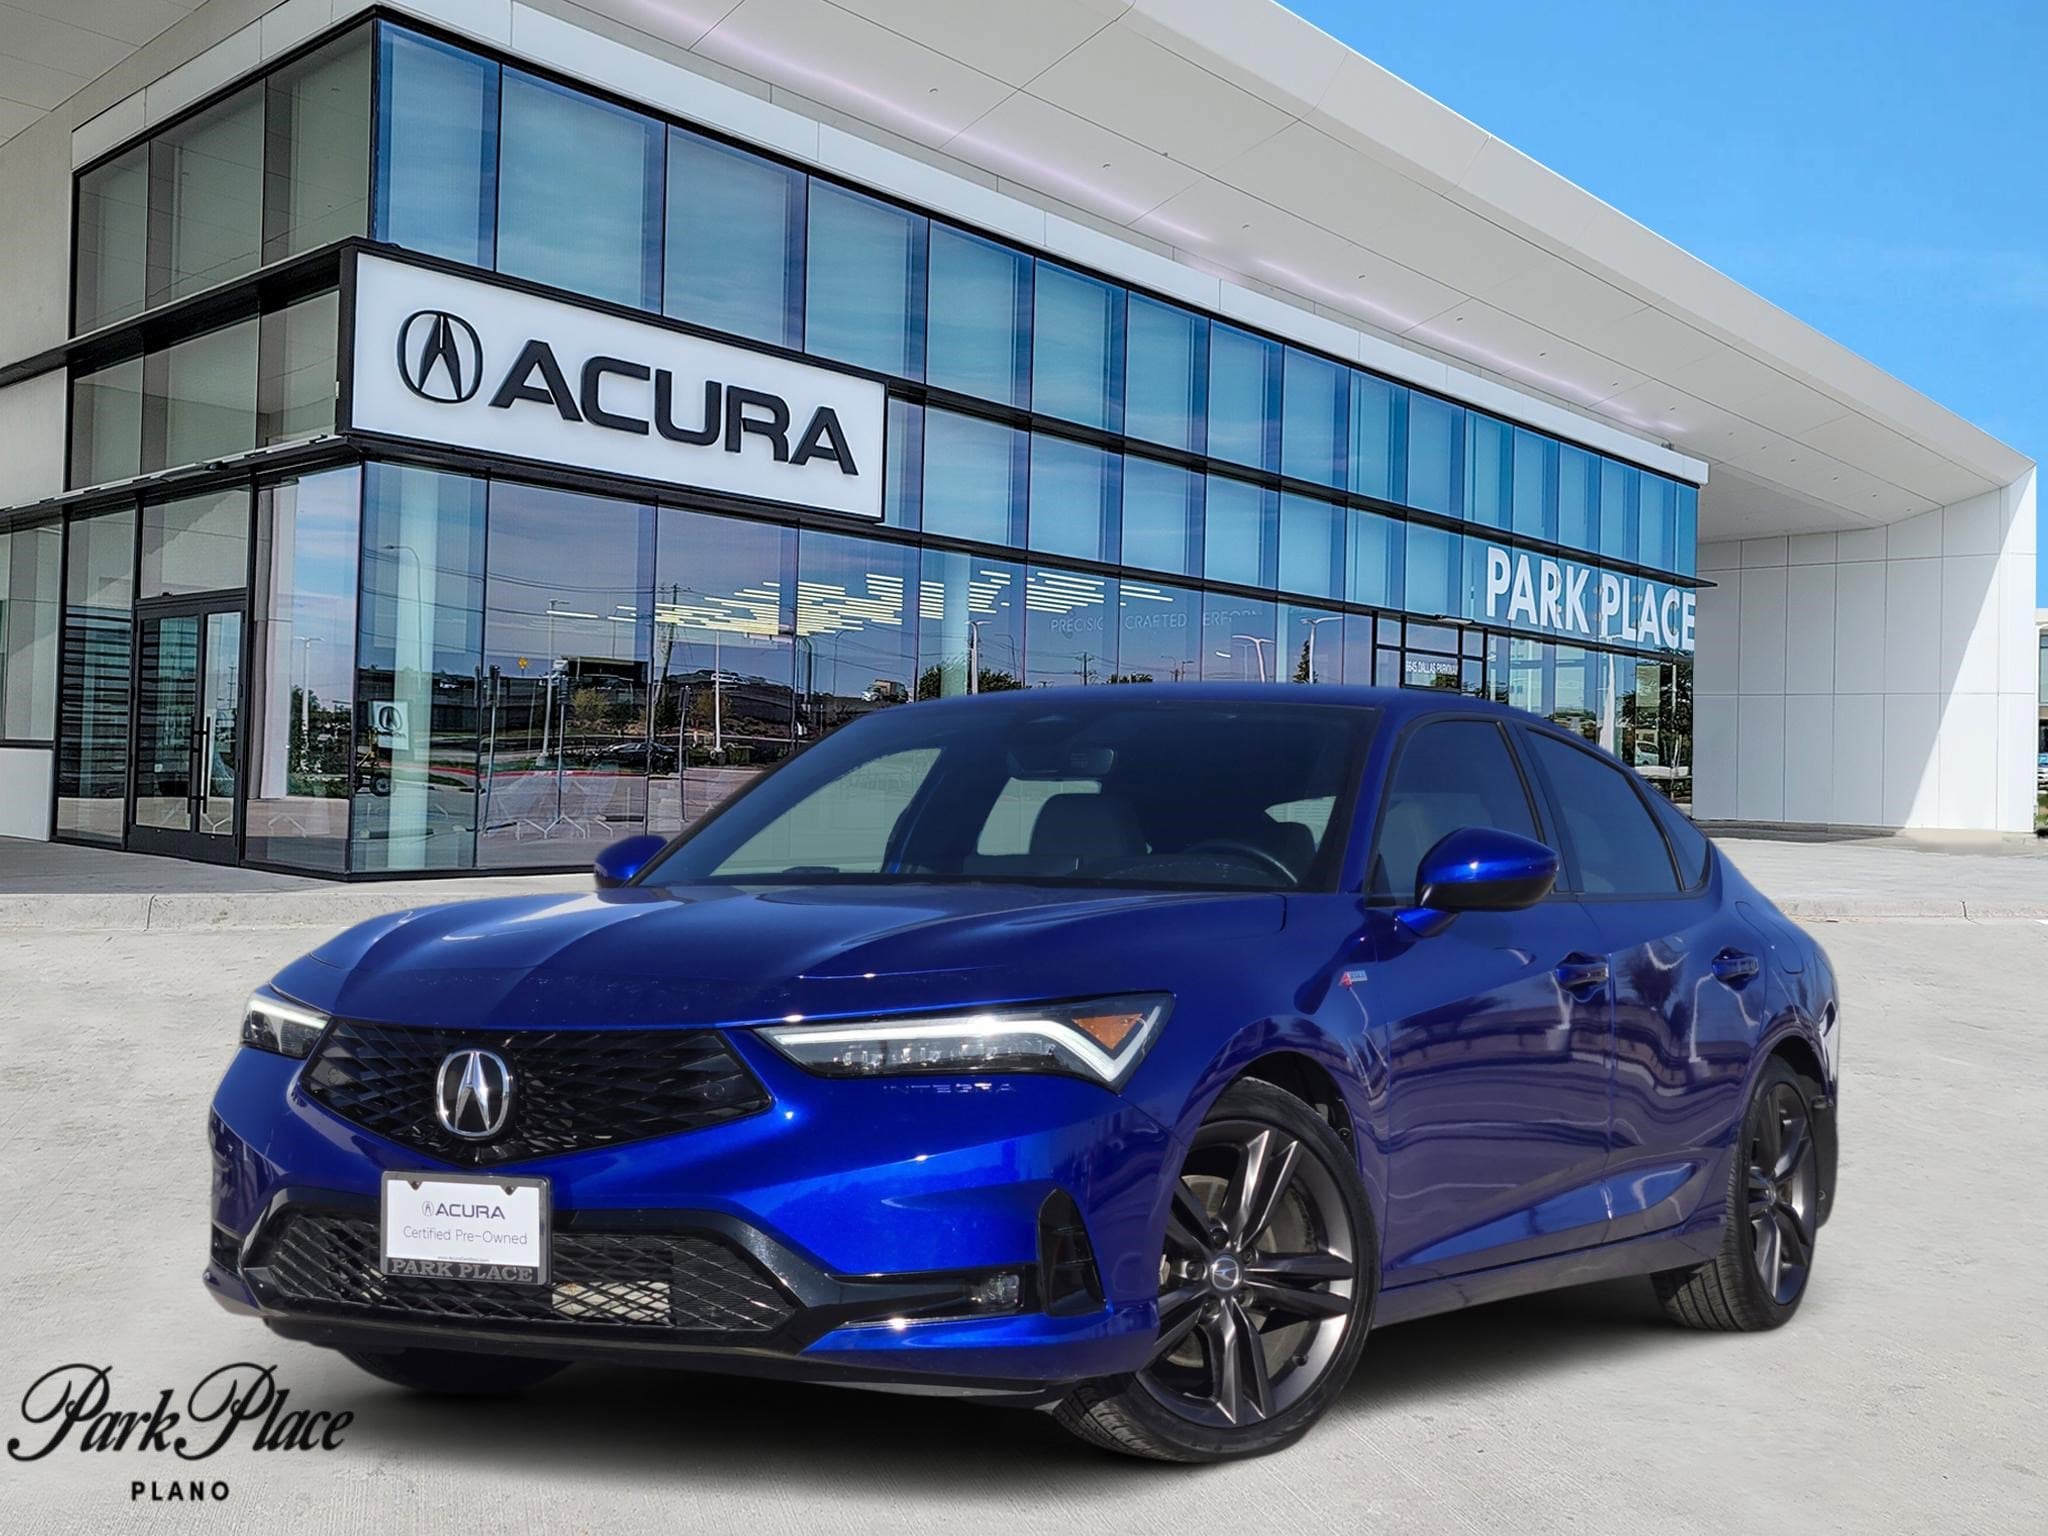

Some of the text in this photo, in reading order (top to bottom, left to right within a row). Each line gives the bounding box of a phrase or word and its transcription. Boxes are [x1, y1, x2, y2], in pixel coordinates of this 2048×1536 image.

[488, 339, 859, 476] ACURA
[1486, 546, 1696, 651] PARK PLACE
[1124, 613, 1188, 630] CRAFTED
[435, 1203, 506, 1220] ACURA
[403, 1225, 528, 1245] Certified Pre-Owned
[391, 1259, 454, 1278] PARK
[458, 1263, 533, 1283] PLACE
